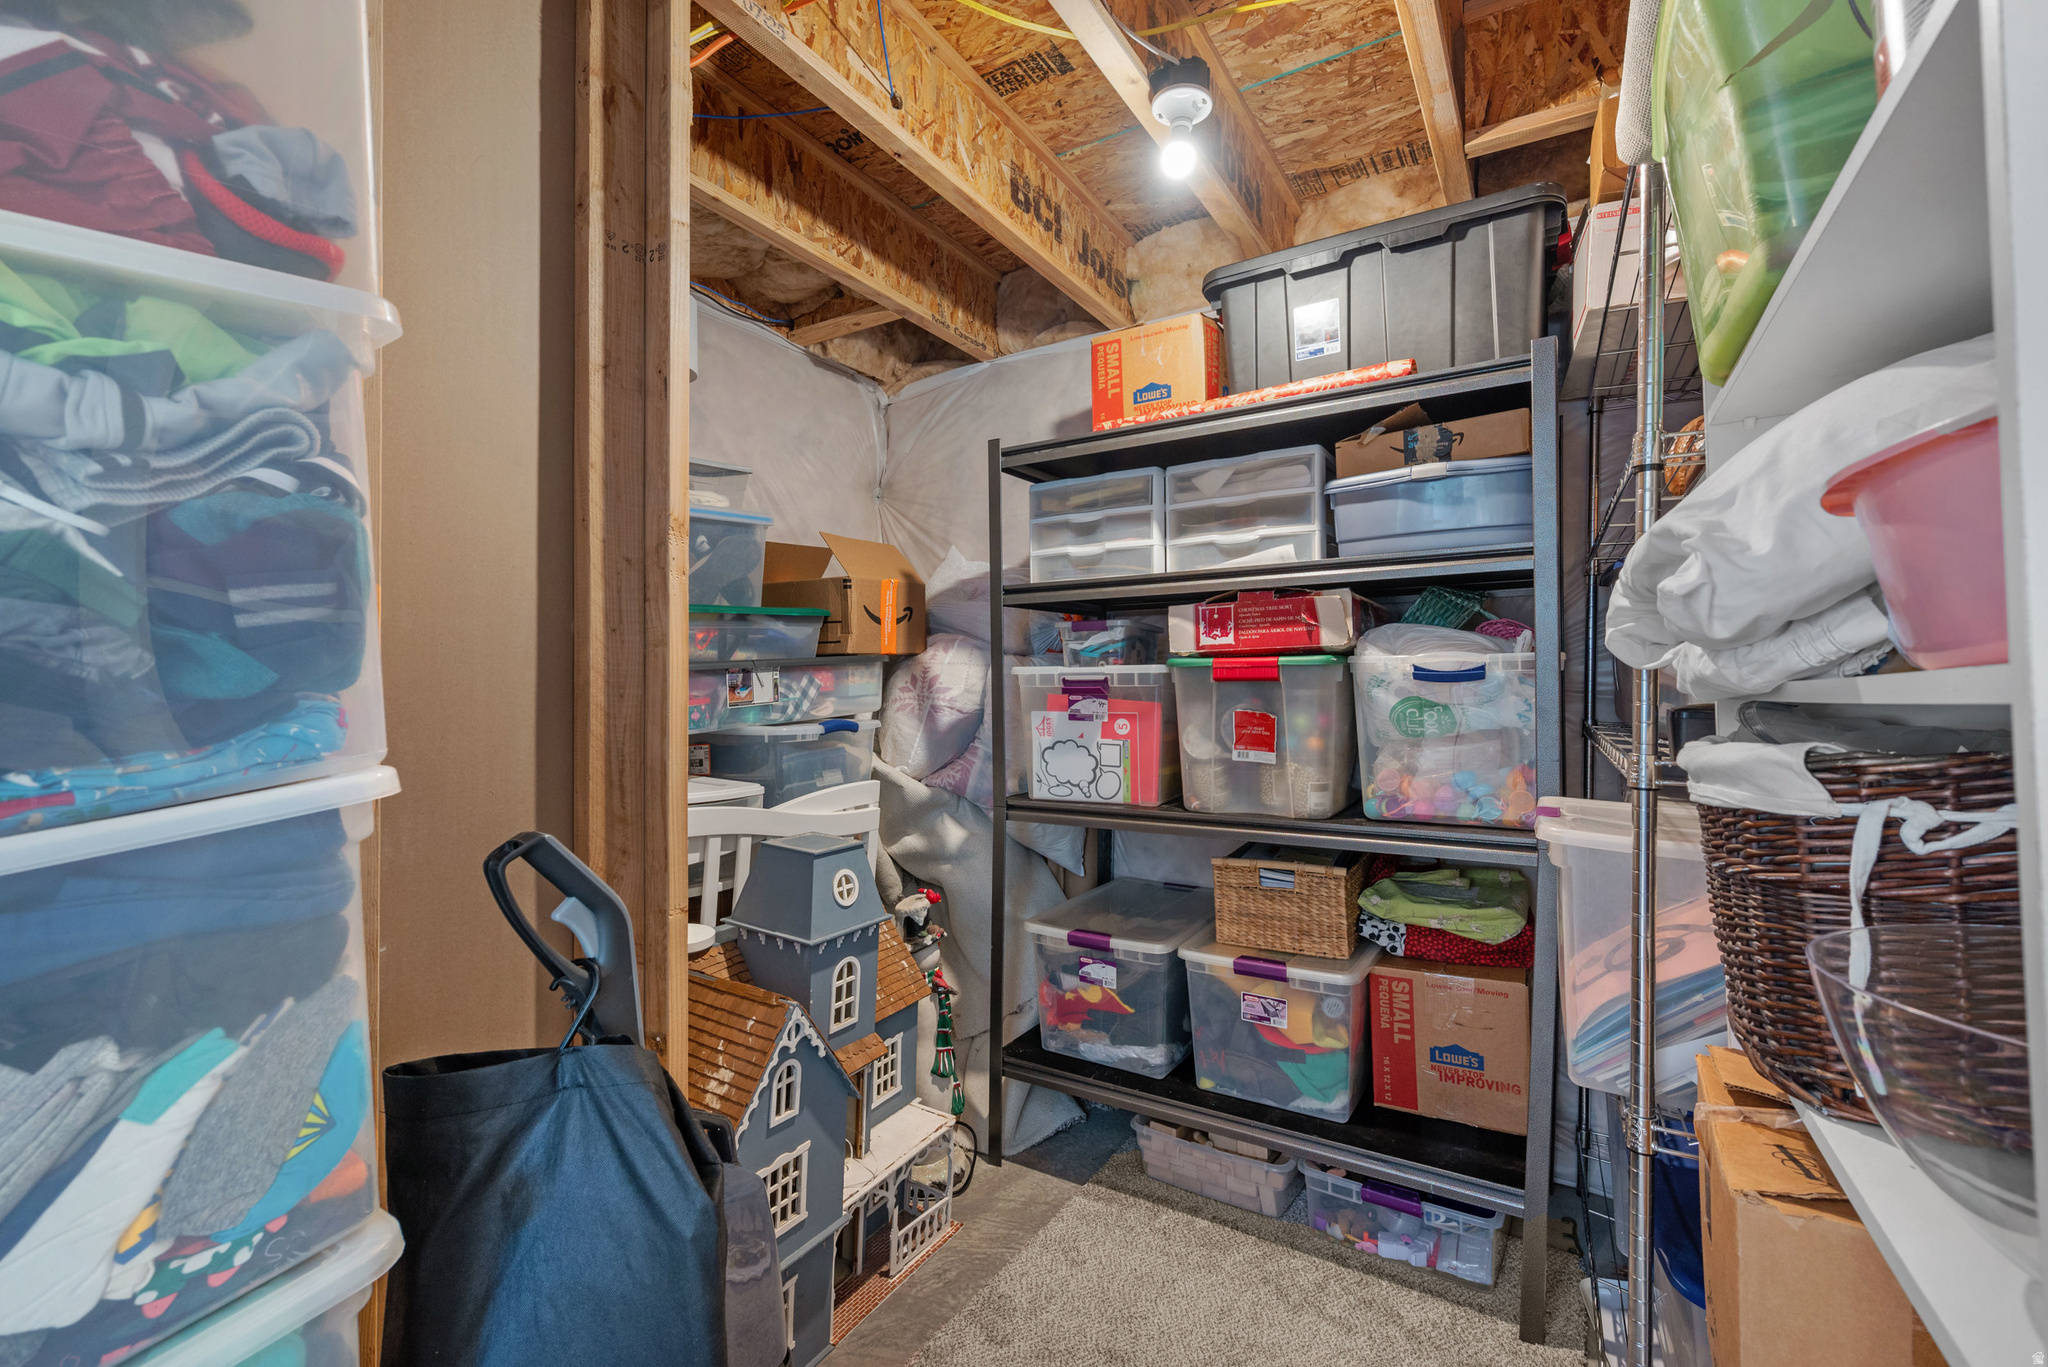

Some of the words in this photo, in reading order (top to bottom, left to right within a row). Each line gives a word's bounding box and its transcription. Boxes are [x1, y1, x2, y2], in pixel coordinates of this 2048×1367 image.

[1077, 229, 1127, 299] Jois
[1096, 345, 1107, 390] PEQUEÑA
[1106, 342, 1121, 399] SMALL
[1136, 388, 1168, 403] LOWE'S
[1378, 978, 1393, 1029] PEQUEÑA
[1391, 980, 1412, 1044] SMALL
[1430, 1064, 1460, 1075] NEVER
[1461, 1069, 1485, 1080] STOP
[1435, 1050, 1479, 1068] LOWE'S
[1438, 1071, 1521, 1096] IMPROVING
